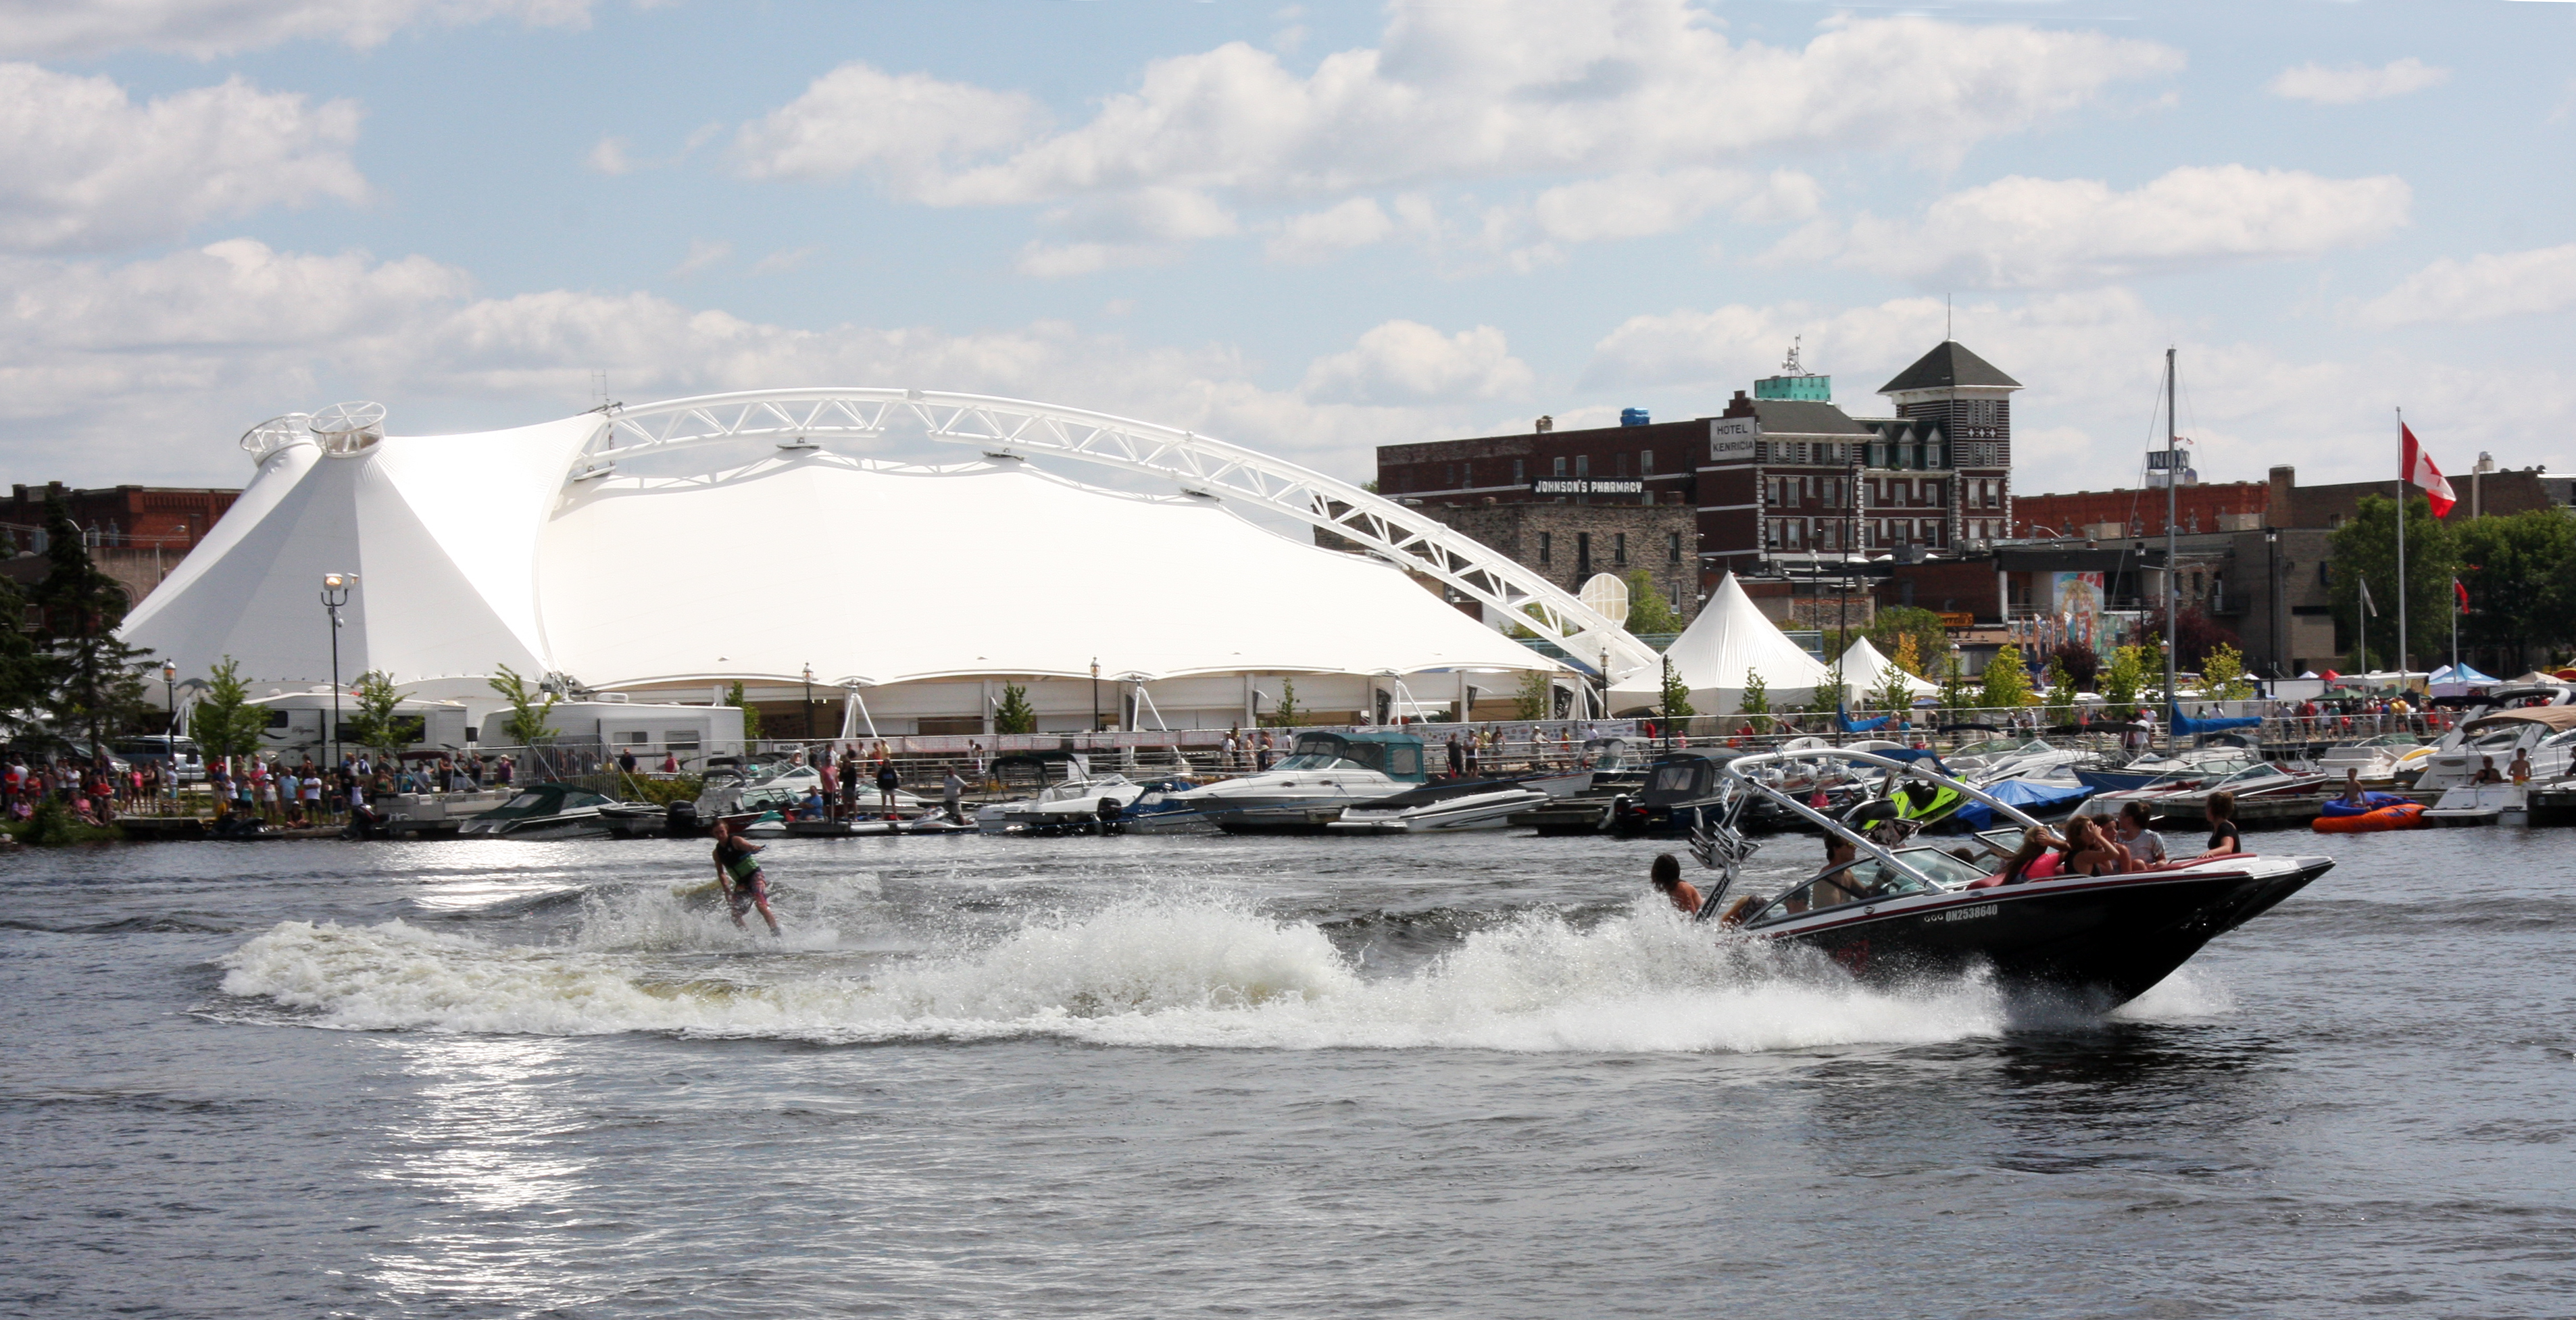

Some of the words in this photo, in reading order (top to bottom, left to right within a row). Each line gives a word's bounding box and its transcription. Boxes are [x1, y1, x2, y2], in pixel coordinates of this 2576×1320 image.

[1717, 424, 1748, 435] HOTEL
[1712, 440, 1754, 453] KENRICIA
[1535, 479, 1587, 492] JOHNSON'S
[1591, 481, 1642, 493] PHARMACY
